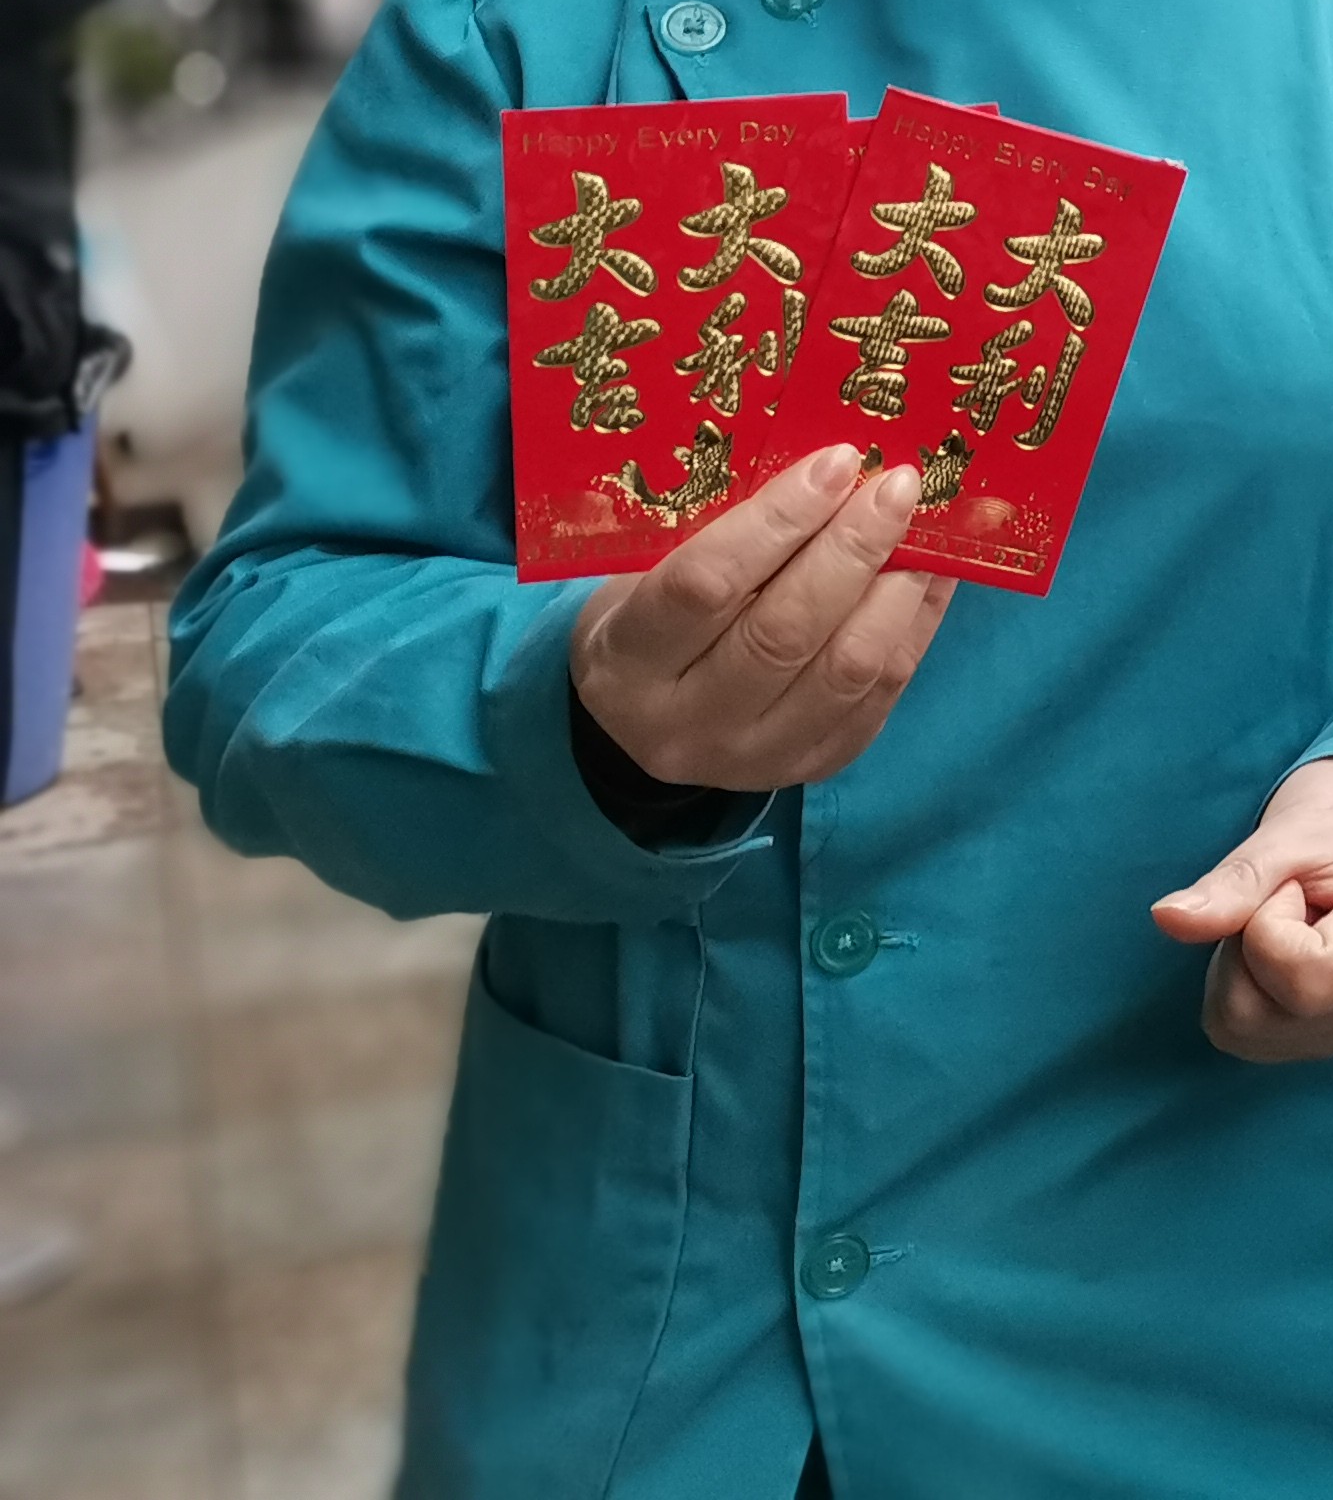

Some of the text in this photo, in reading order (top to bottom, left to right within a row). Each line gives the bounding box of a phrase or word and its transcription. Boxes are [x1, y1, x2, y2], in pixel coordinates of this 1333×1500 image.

[521, 120, 798, 157] Happy Every Day
[892, 114, 983, 161] Happy
[993, 141, 1070, 185] Every
[1083, 166, 1135, 203] Day
[528, 170, 662, 433] 大吉
[828, 162, 978, 421] 大吉
[949, 197, 1106, 451] 大利
